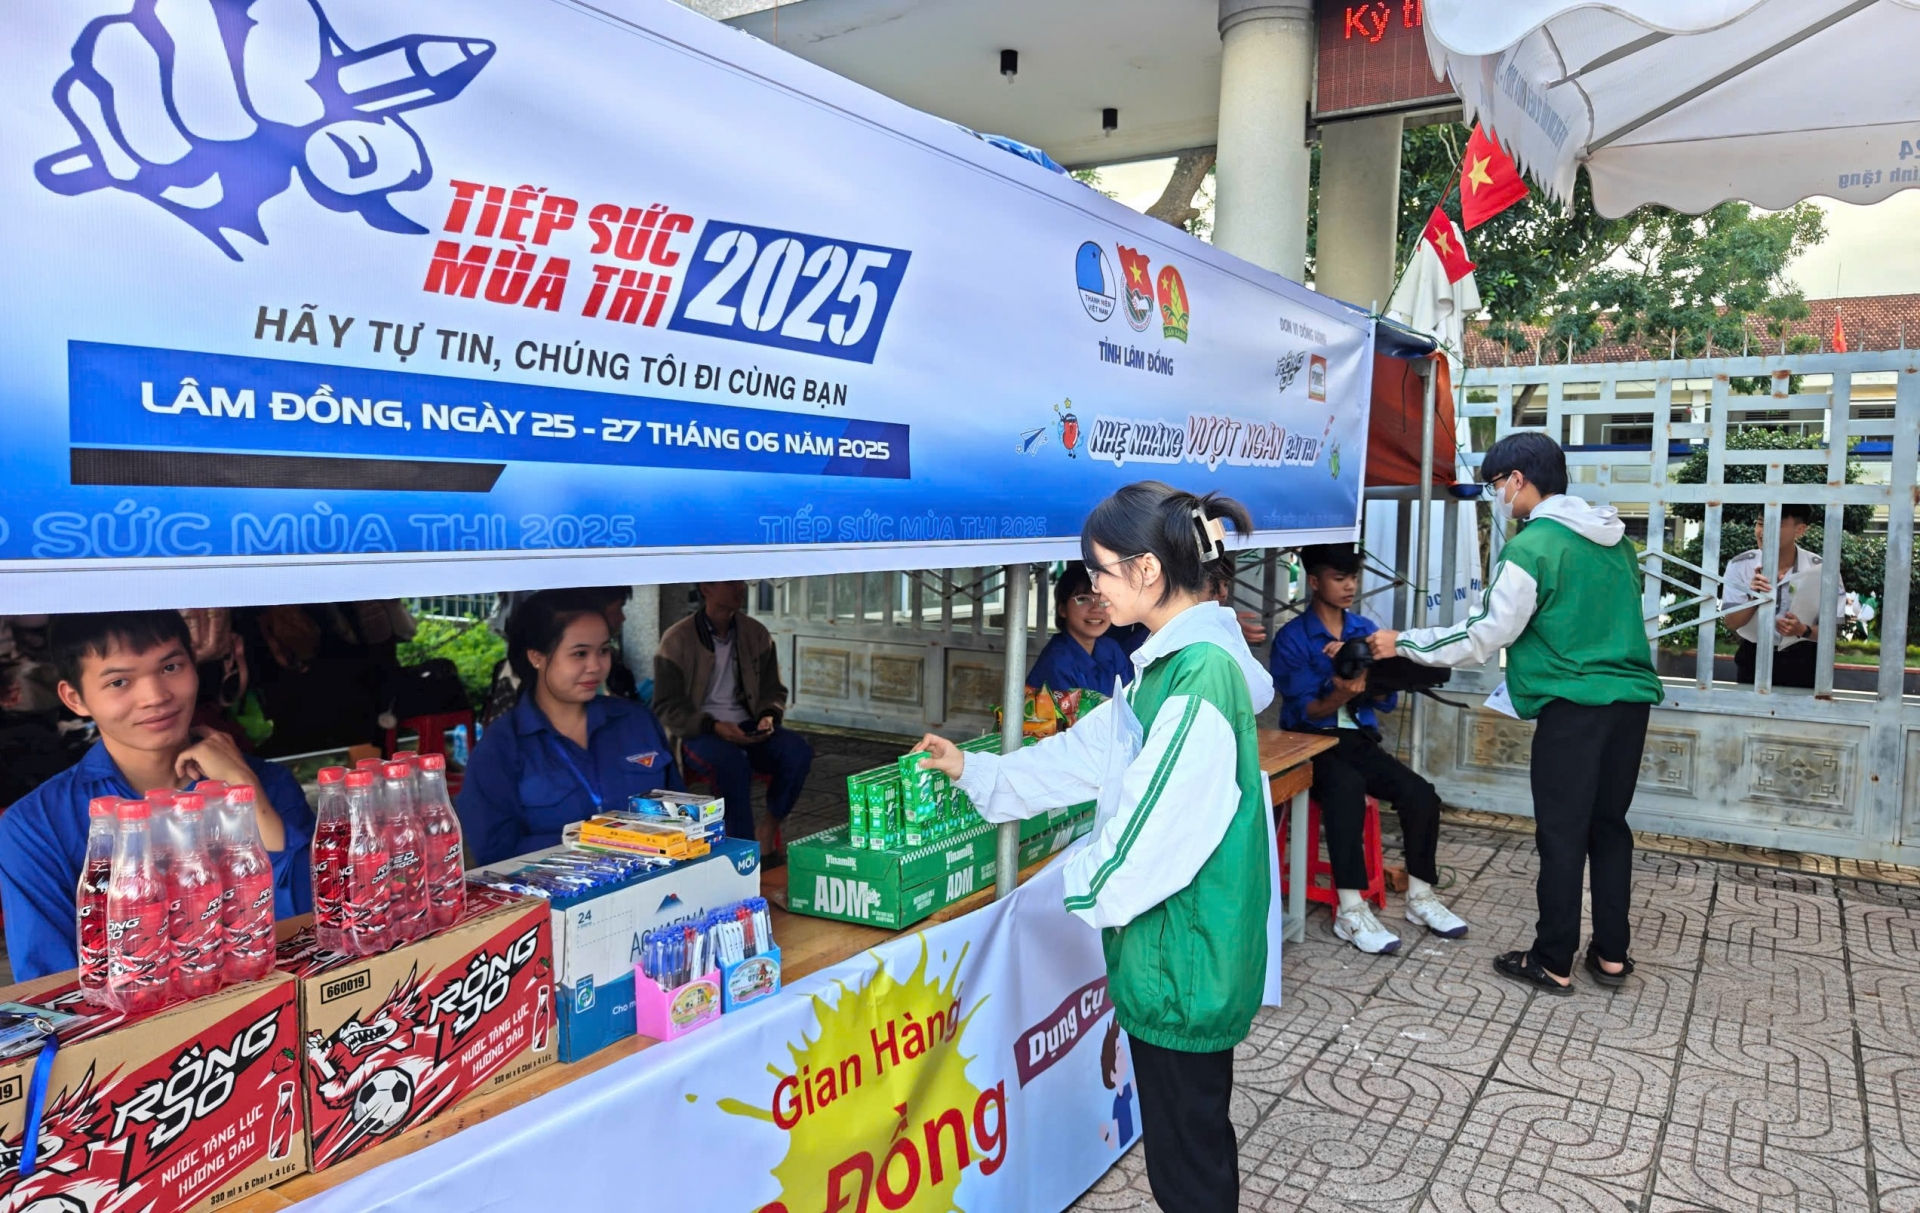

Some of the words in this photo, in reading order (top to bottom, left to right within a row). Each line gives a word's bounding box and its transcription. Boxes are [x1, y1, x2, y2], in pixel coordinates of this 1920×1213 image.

[443, 178, 579, 246] TIẾP
[588, 203, 694, 267] SỨC
[423, 240, 571, 312] MÙA
[581, 264, 672, 327] THI
[683, 229, 893, 346] 2025
[254, 303, 355, 348] HÃY
[368, 319, 425, 363] TỰ
[436, 329, 500, 372] TIN,
[515, 340, 630, 381] CHÚNG
[640, 353, 687, 388] TÔI
[694, 364, 721, 391] ĐI
[728, 366, 796, 400] CÙNG
[802, 379, 848, 409] BẠN
[1098, 336, 1121, 365] TỈNH
[1124, 345, 1144, 370] LÂM
[141, 377, 256, 419] LÂM
[268, 384, 411, 431] ĐỒNG,
[422, 401, 525, 435] NGÀY
[531, 412, 576, 439] 25
[601, 417, 642, 443] 27
[646, 420, 740, 450] THÁNG
[745, 430, 779, 453] 06
[785, 431, 834, 457] NĂM
[838, 438, 890, 460] 2025
[1090, 420, 1131, 461] NHẸ
[1128, 422, 1184, 458] NHÀNG
[1186, 415, 1242, 464] VƯỢT
[32, 499, 213, 558] SỨC
[230, 501, 397, 556] MÙA
[408, 513, 507, 551] THI
[519, 513, 637, 549] 2025
[759, 503, 832, 544] TIẾP
[838, 508, 894, 543] SỨC
[900, 509, 956, 541] MÙA
[961, 516, 998, 540] THI
[1000, 516, 1047, 539] 2025
[825, 854, 857, 869] Vinamilk
[945, 843, 974, 866] Vinamilk
[814, 875, 870, 919] ADM
[945, 865, 974, 903] ADM
[578, 910, 593, 925] 24
[326, 976, 365, 999] 660019
[612, 1002, 628, 1015] Cho
[461, 1036, 487, 1067] NƯỚC
[489, 1020, 511, 1045] TĂNG
[512, 1002, 530, 1025] LỰC
[472, 1044, 504, 1078] HƯƠNG
[505, 1025, 524, 1049] DÂU
[1028, 1005, 1079, 1067] Dụng
[1080, 986, 1106, 1020] Cụ
[771, 1053, 862, 1131] Gian
[869, 996, 963, 1076] Hàng
[161, 1149, 200, 1188] NƯỚC
[202, 1126, 236, 1158] TĂNG
[239, 1103, 264, 1131] LỰC
[178, 1157, 225, 1199] HƯƠNG
[228, 1130, 256, 1161] DÂU
[823, 1079, 1008, 1213] Đồng
[210, 1191, 225, 1205] 330
[226, 1187, 236, 1198] ml
[244, 1181, 250, 1191] 6
[251, 1174, 267, 1188] Chai
[275, 1168, 280, 1177] 4
